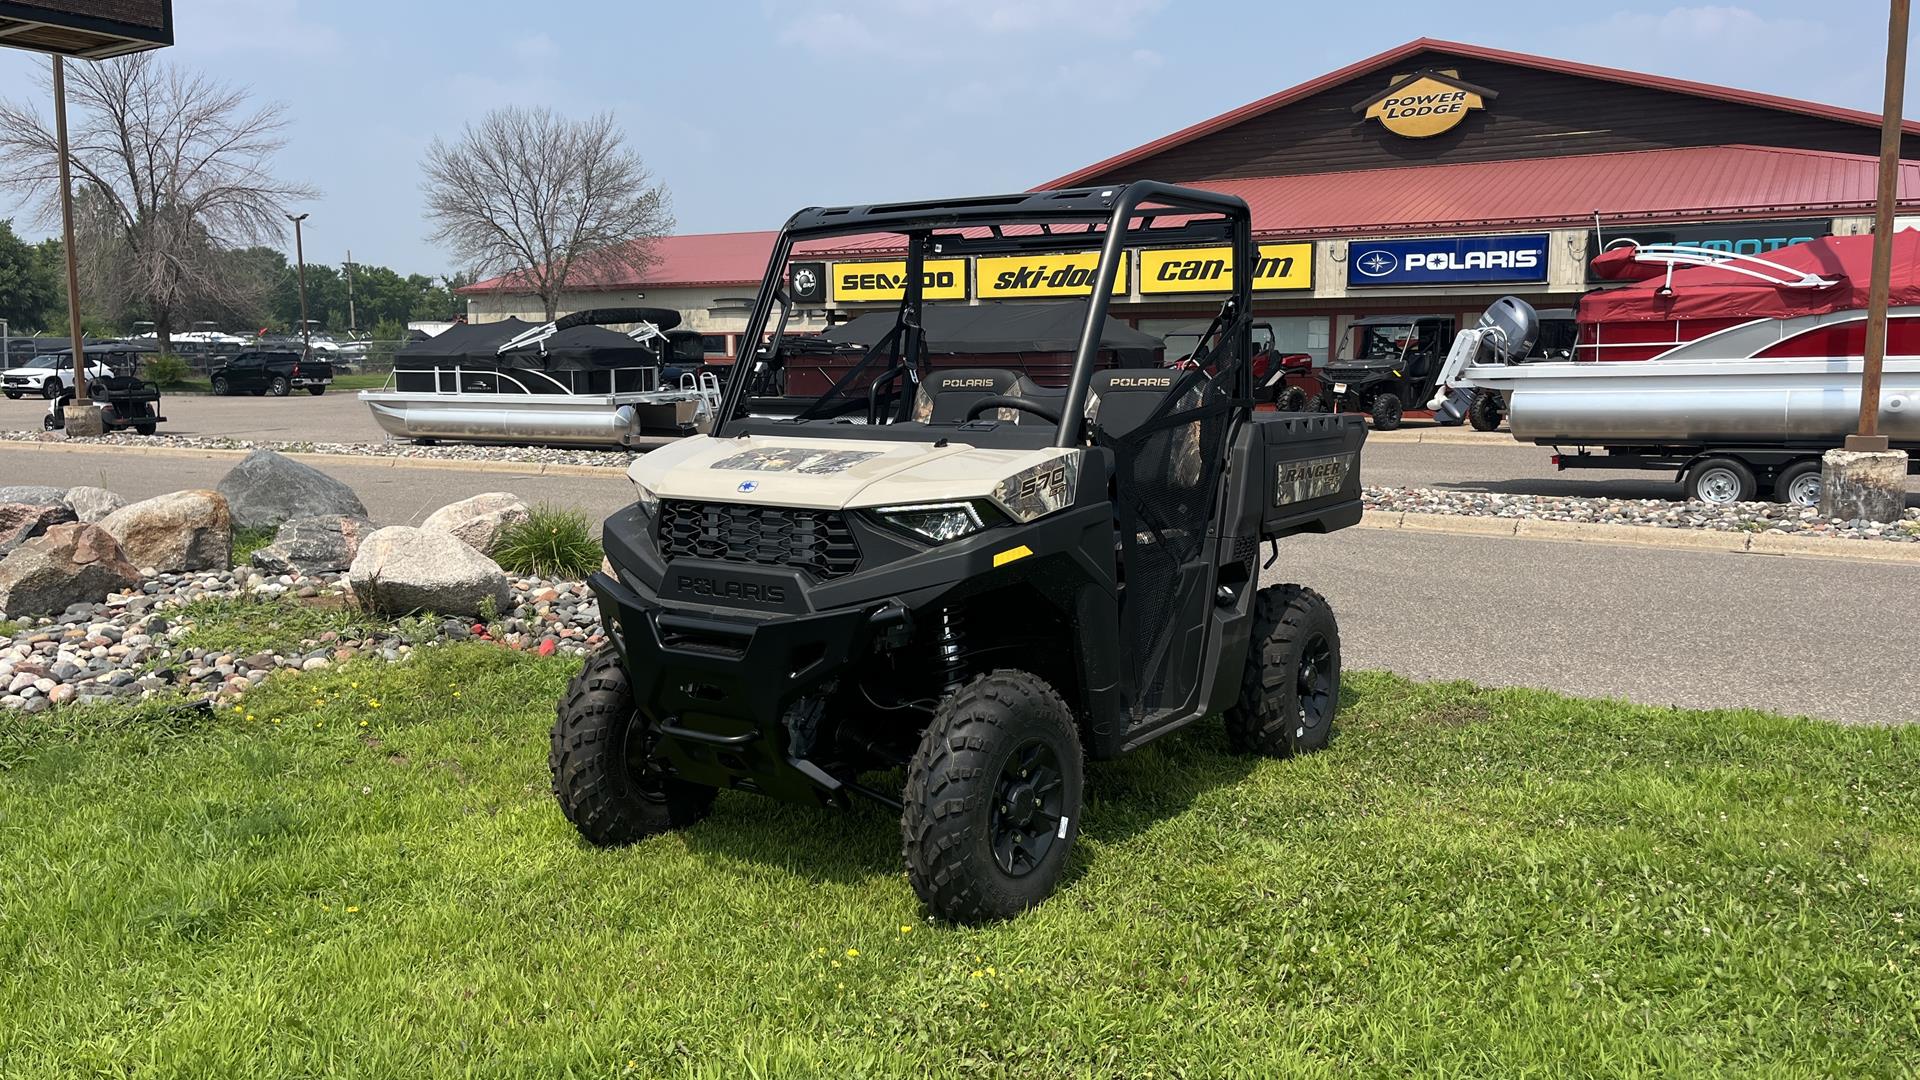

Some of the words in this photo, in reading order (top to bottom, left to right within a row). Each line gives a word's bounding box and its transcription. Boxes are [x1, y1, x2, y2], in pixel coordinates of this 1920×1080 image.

[1382, 91, 1467, 110] POWER
[1386, 103, 1462, 119] LODGE
[1156, 257, 1294, 281] can-m
[1405, 250, 1538, 271] POLARIS
[942, 379, 994, 387] POLARIS
[1110, 378, 1171, 387] POLARIS
[1020, 465, 1066, 499] 570
[1284, 462, 1341, 483] RANGER
[678, 575, 785, 605] POLARIS
